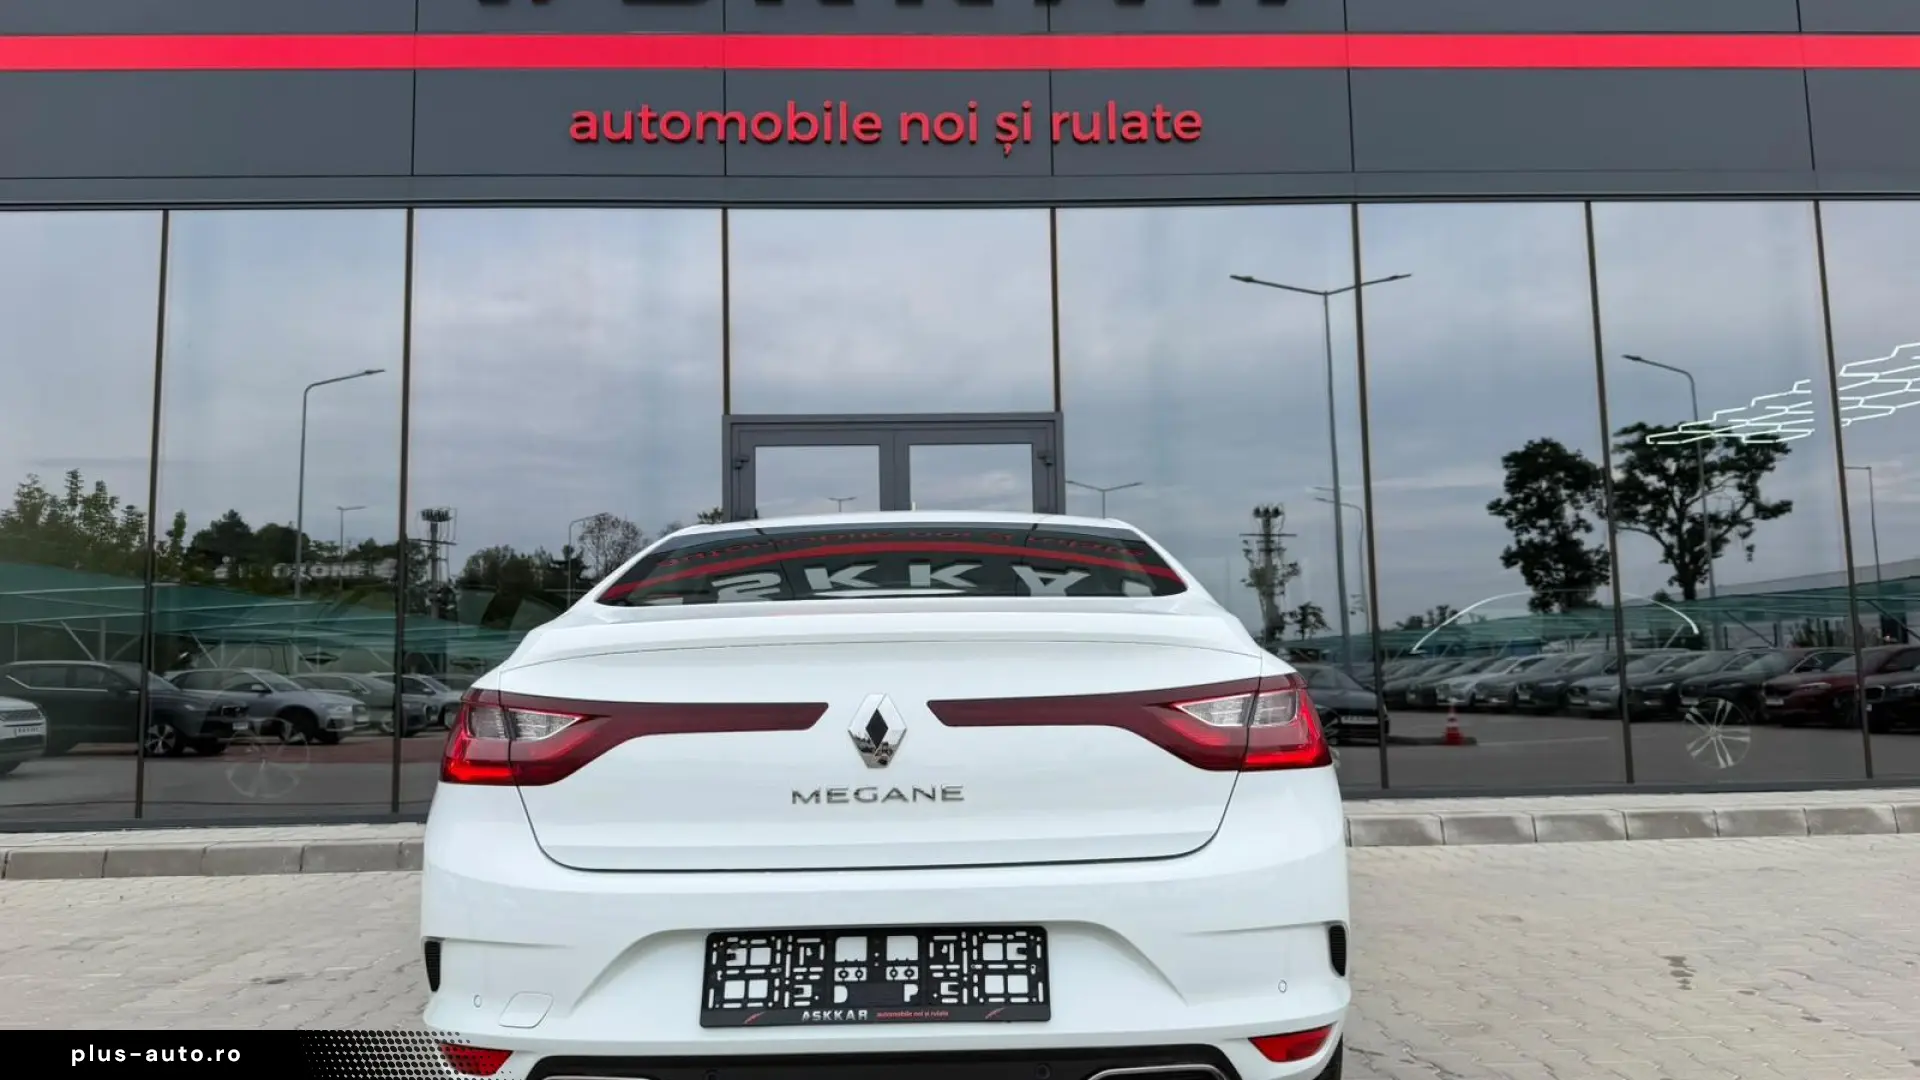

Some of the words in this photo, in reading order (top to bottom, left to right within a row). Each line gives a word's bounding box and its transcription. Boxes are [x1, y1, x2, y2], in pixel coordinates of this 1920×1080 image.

[570, 100, 883, 144] automobile
[900, 100, 978, 143] noi
[995, 101, 1033, 155] și
[1052, 101, 1202, 143] rulate
[792, 785, 965, 805] MEGANE
[801, 1009, 869, 1022] ASKKAR
